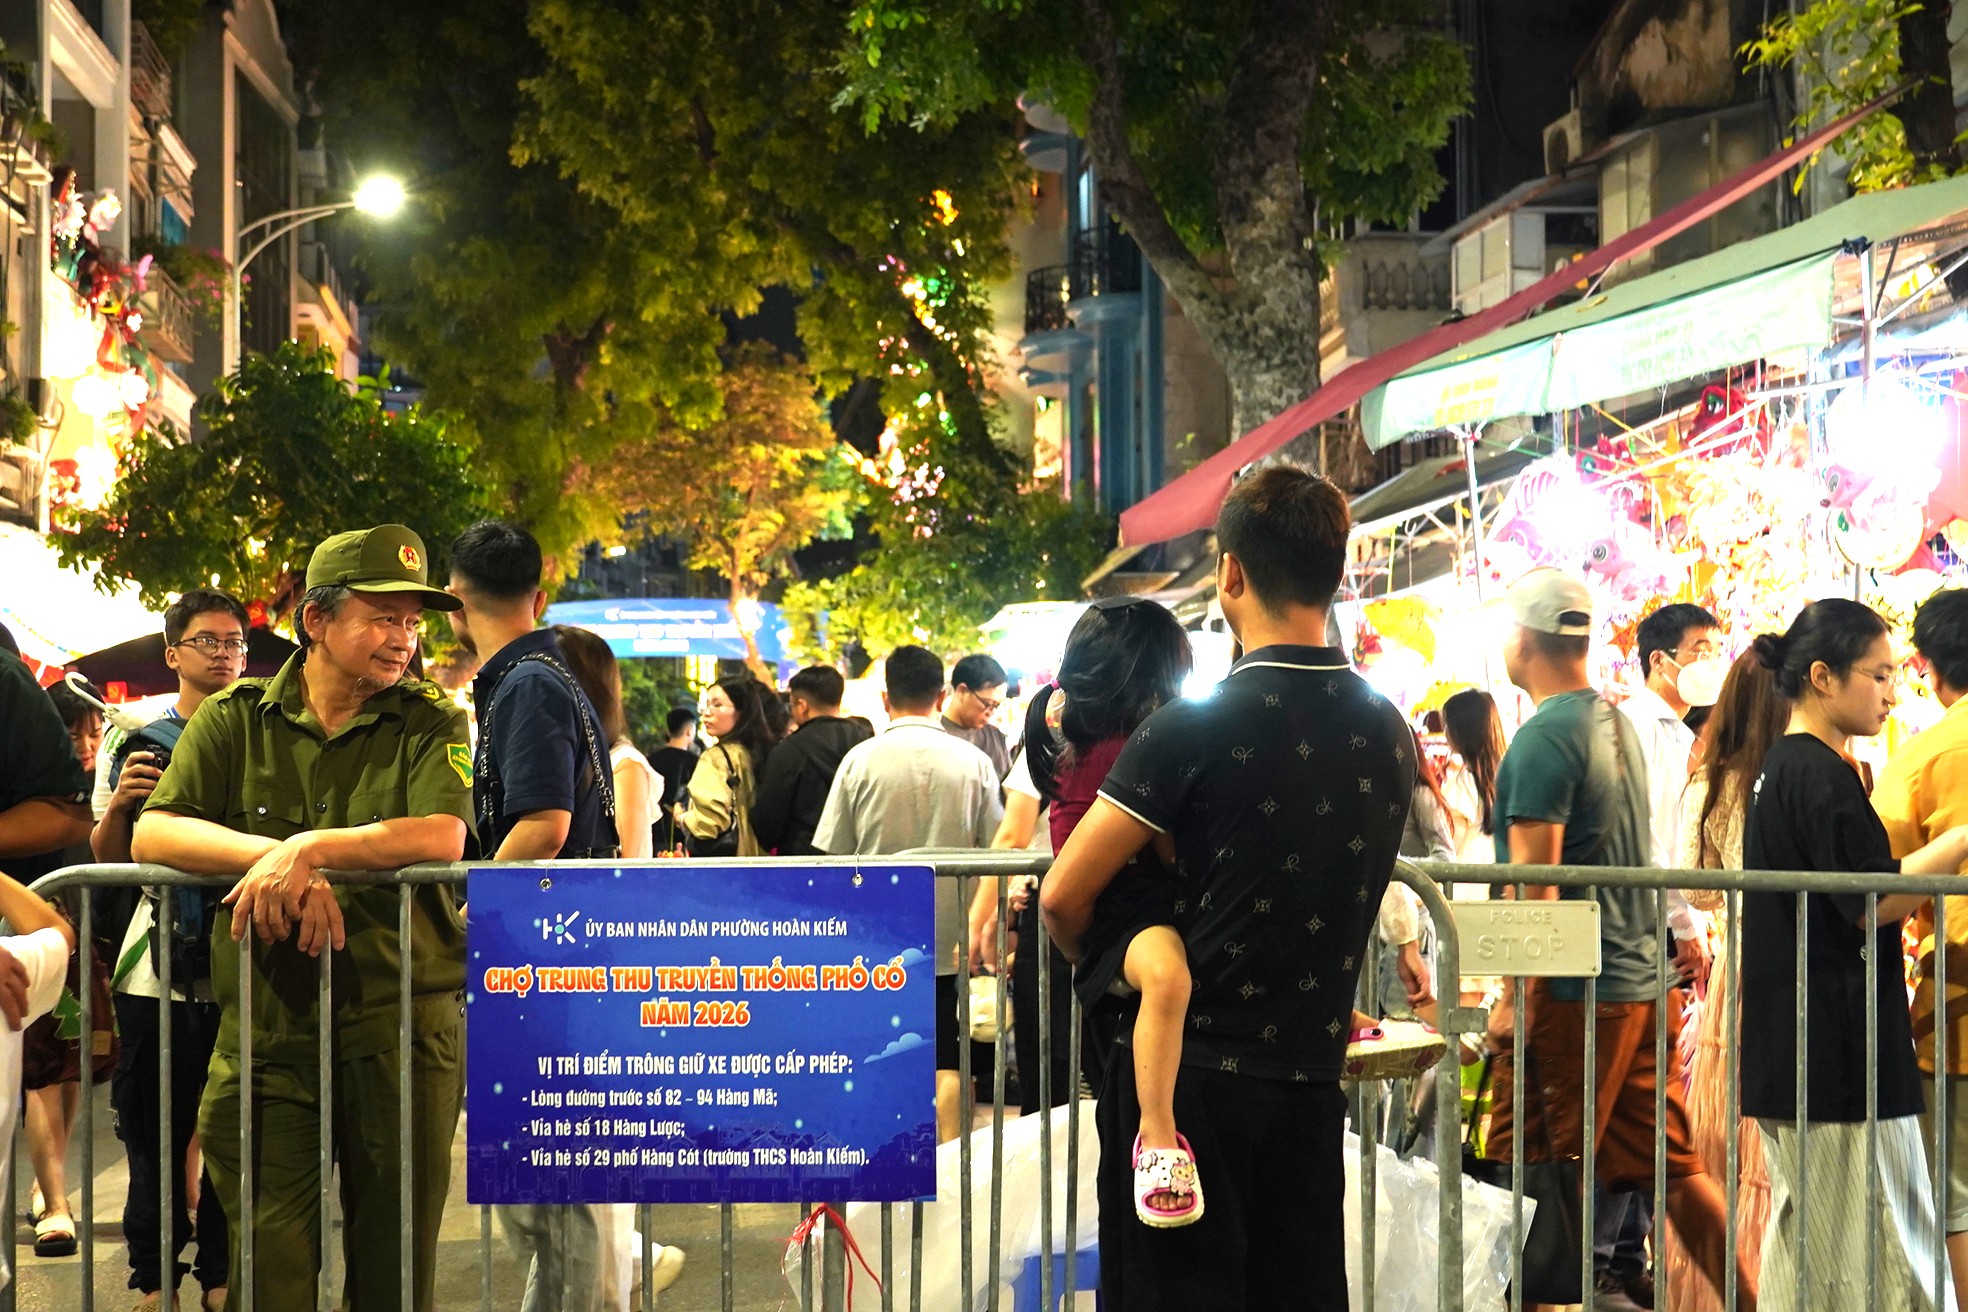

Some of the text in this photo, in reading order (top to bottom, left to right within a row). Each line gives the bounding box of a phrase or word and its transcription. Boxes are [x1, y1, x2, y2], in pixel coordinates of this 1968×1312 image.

[585, 916, 847, 937] ỦY BAN NHÂN DÂN PHƯỜNG HOÀN KIẾM
[1490, 909, 1552, 925] POLICE
[1477, 934, 1564, 960] STOP
[484, 956, 906, 998] CHỢ TRUNG THU TRUYỀN THỐNG PHỐ CỔ
[640, 997, 751, 1027] NĂM 2026
[538, 1049, 853, 1078] VỊ TRÍ ĐIỂM TRÔNG GIỮ XE ĐƯỢC CẤP PHÉP:
[531, 1089, 562, 1108] Lòng
[566, 1089, 605, 1108] đường
[609, 1089, 643, 1106] trước
[647, 1087, 663, 1105] số
[665, 1089, 682, 1105] 82
[696, 1089, 713, 1105] 94
[717, 1089, 749, 1107] Hàng
[753, 1088, 778, 1106] Mã;
[531, 1118, 551, 1136] Vỉa
[555, 1119, 571, 1136] hè
[575, 1117, 591, 1135] số
[594, 1119, 610, 1135] 18
[613, 1119, 646, 1137] Hàng
[650, 1119, 685, 1139] Lược;
[531, 1148, 551, 1166] Vỉa
[555, 1149, 571, 1166] hè
[575, 1147, 591, 1166] số
[594, 1149, 610, 1165] 29
[614, 1147, 639, 1167] phố
[641, 1149, 674, 1167] Hàng
[678, 1148, 699, 1166] Cót
[704, 1148, 750, 1167] (trường
[753, 1149, 787, 1166] THCS
[790, 1148, 823, 1165] Hoàn
[827, 1145, 870, 1166] Kiếm).
